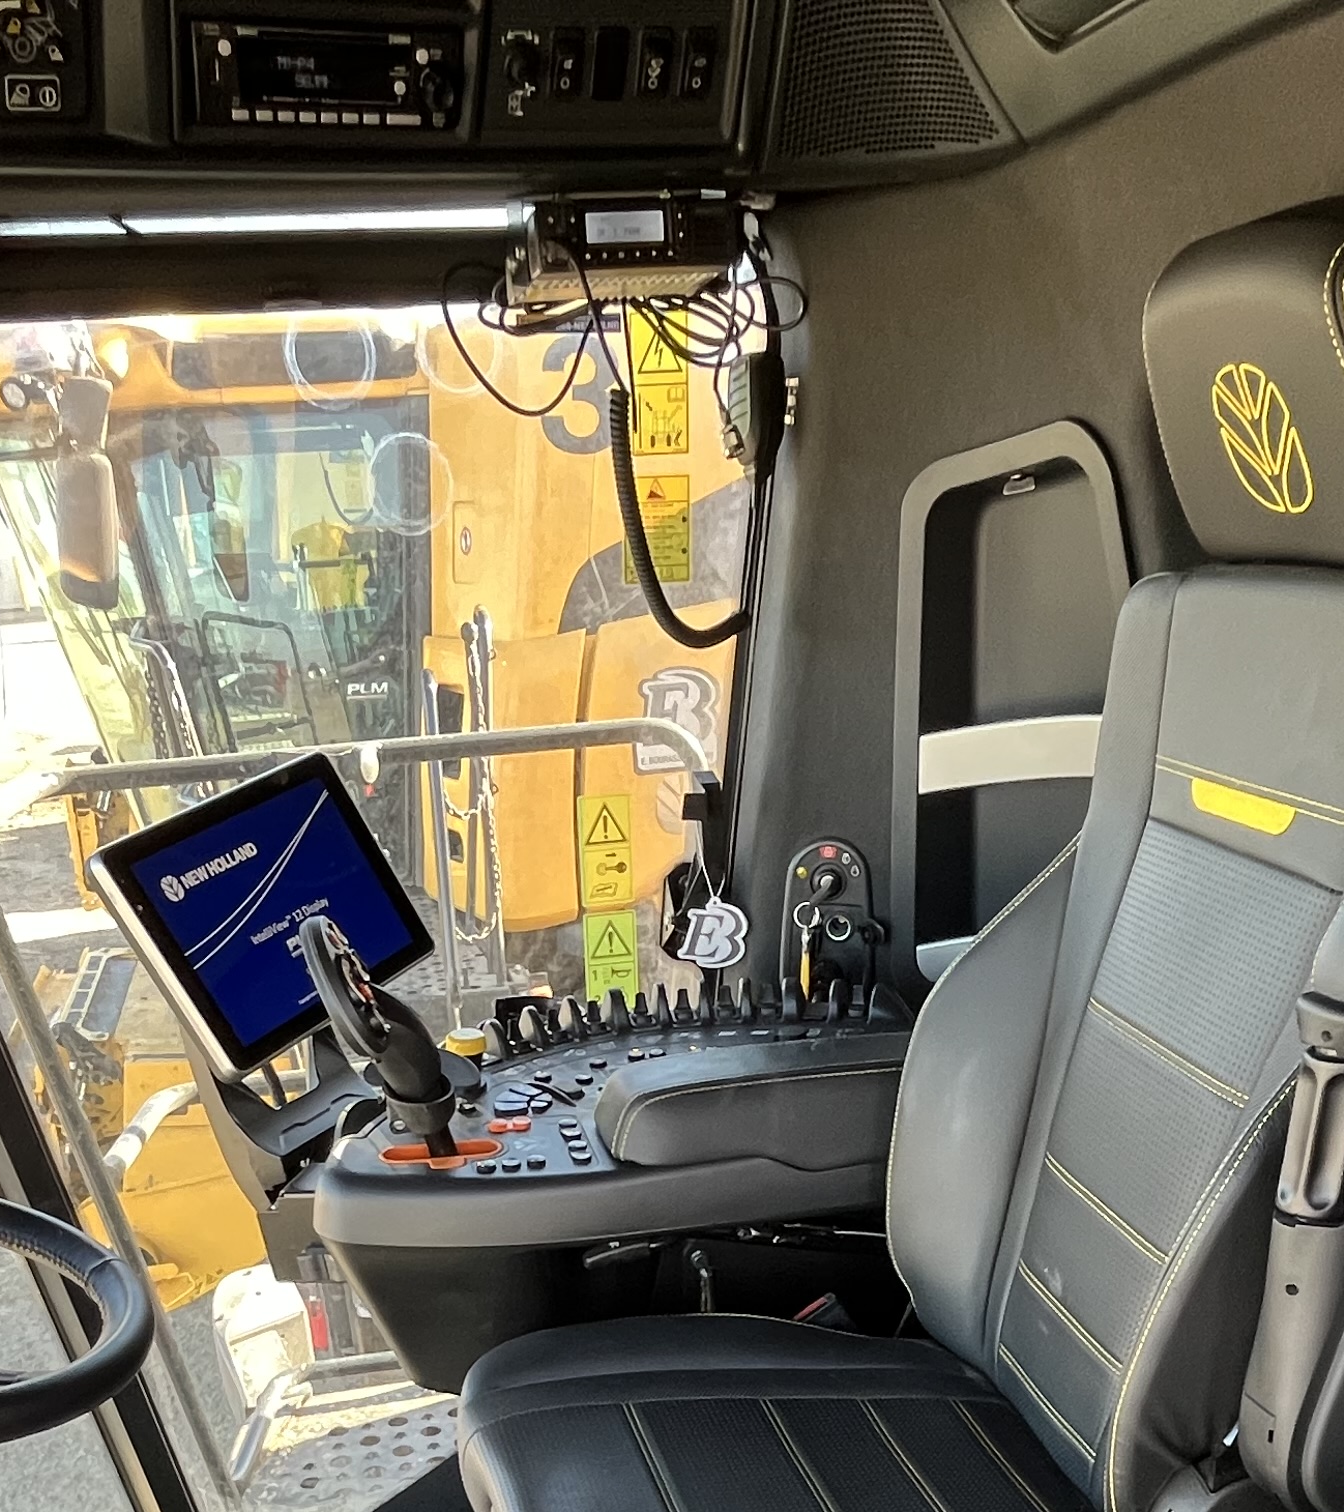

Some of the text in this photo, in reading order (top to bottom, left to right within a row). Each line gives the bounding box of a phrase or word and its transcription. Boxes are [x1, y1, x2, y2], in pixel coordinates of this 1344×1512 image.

[541, 335, 622, 455] 3
[347, 681, 388, 695] PLM
[179, 842, 258, 890] NEW HOLLAND
[292, 909, 305, 922] 12
